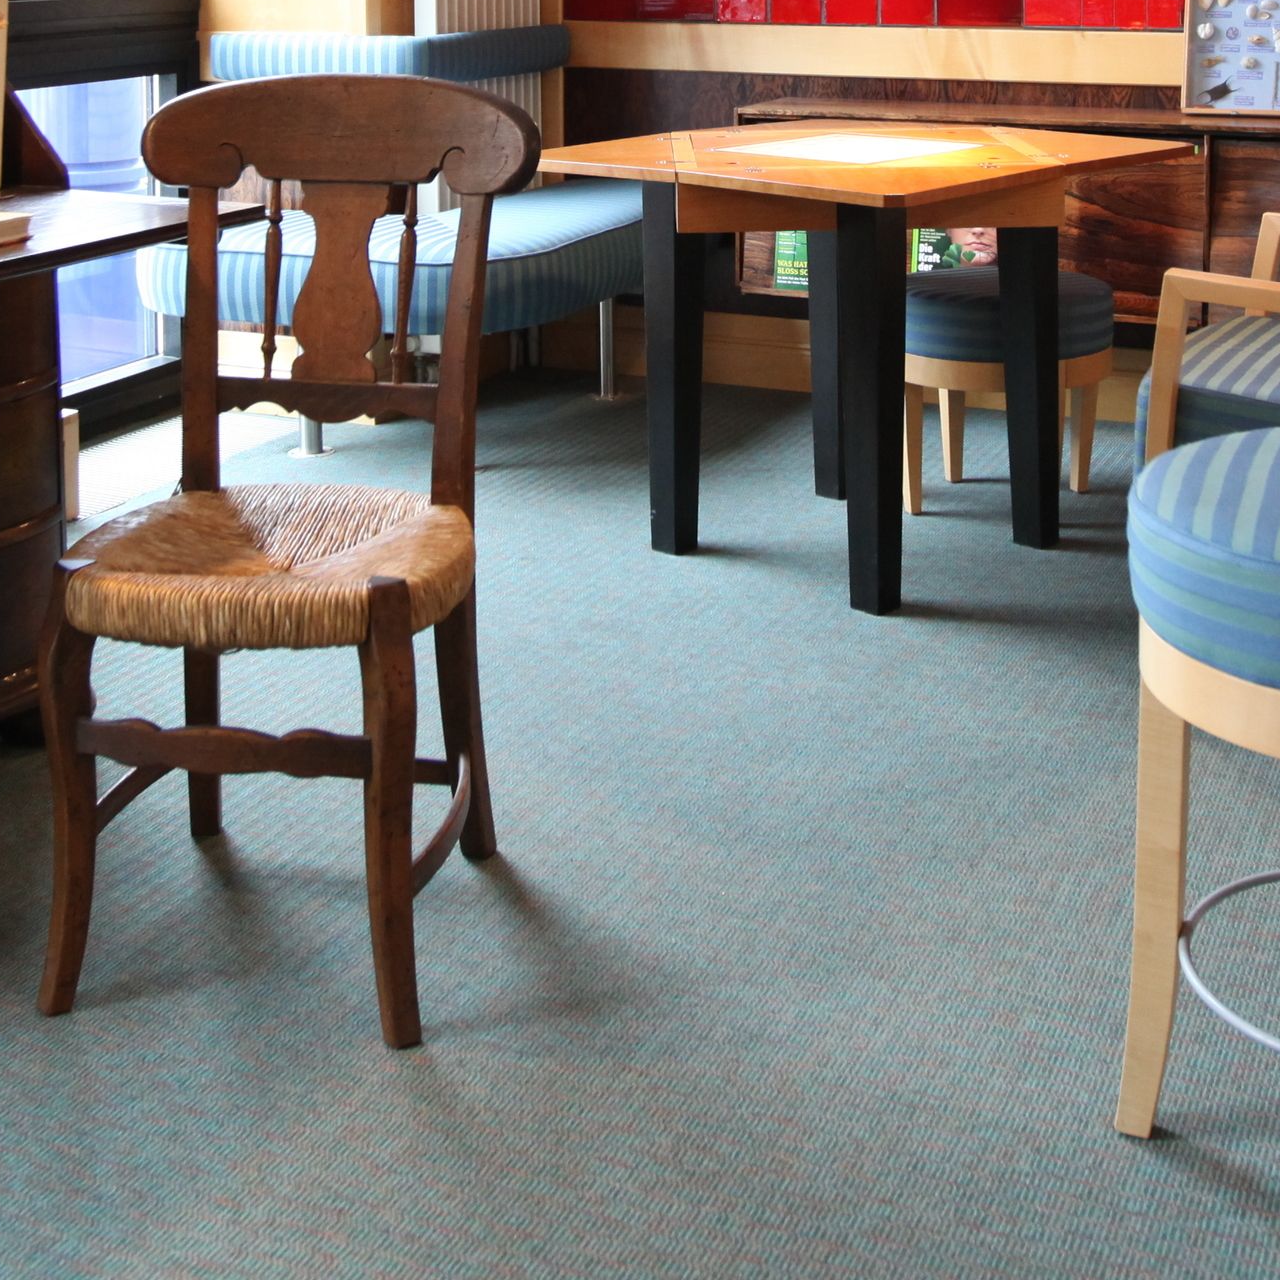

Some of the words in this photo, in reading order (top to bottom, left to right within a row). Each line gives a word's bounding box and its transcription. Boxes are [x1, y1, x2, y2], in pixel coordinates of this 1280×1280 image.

[919, 243, 933, 253] Die
[919, 253, 940, 263] Kraft
[918, 262, 933, 271] der
